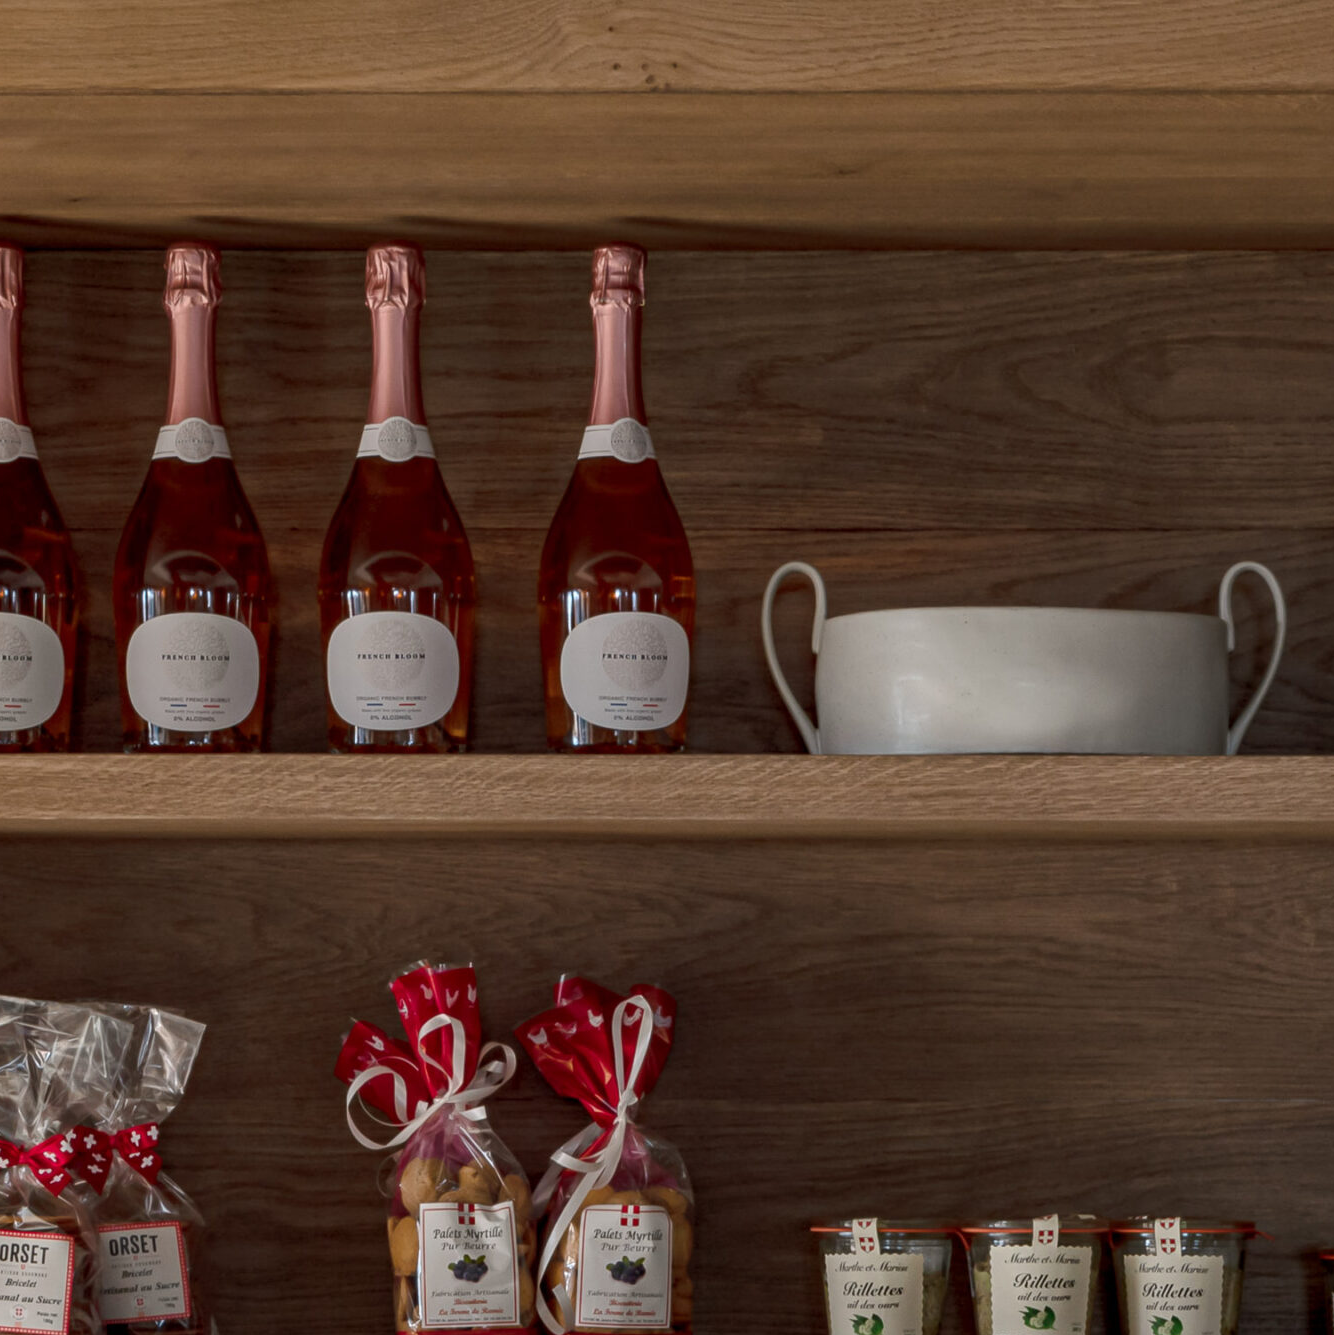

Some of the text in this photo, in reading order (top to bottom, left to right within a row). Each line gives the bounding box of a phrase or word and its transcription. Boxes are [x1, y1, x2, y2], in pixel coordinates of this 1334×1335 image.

[433, 1226, 503, 1242] Palets Myrtille
[593, 1228, 663, 1244] Palets Myrtille
[109, 1234, 158, 1256] ORSET
[441, 1242, 496, 1251] Pur Beurre
[601, 1243, 657, 1253] Pur Beurre
[0, 1244, 49, 1265] ORSET
[141, 1284, 152, 1292] au
[843, 1281, 904, 1297] Rillettes
[1013, 1273, 1076, 1289] Rillettes
[1032, 1292, 1048, 1301] des
[1142, 1282, 1204, 1299] Rillettes
[860, 1300, 875, 1309] des
[1159, 1301, 1174, 1311] des
